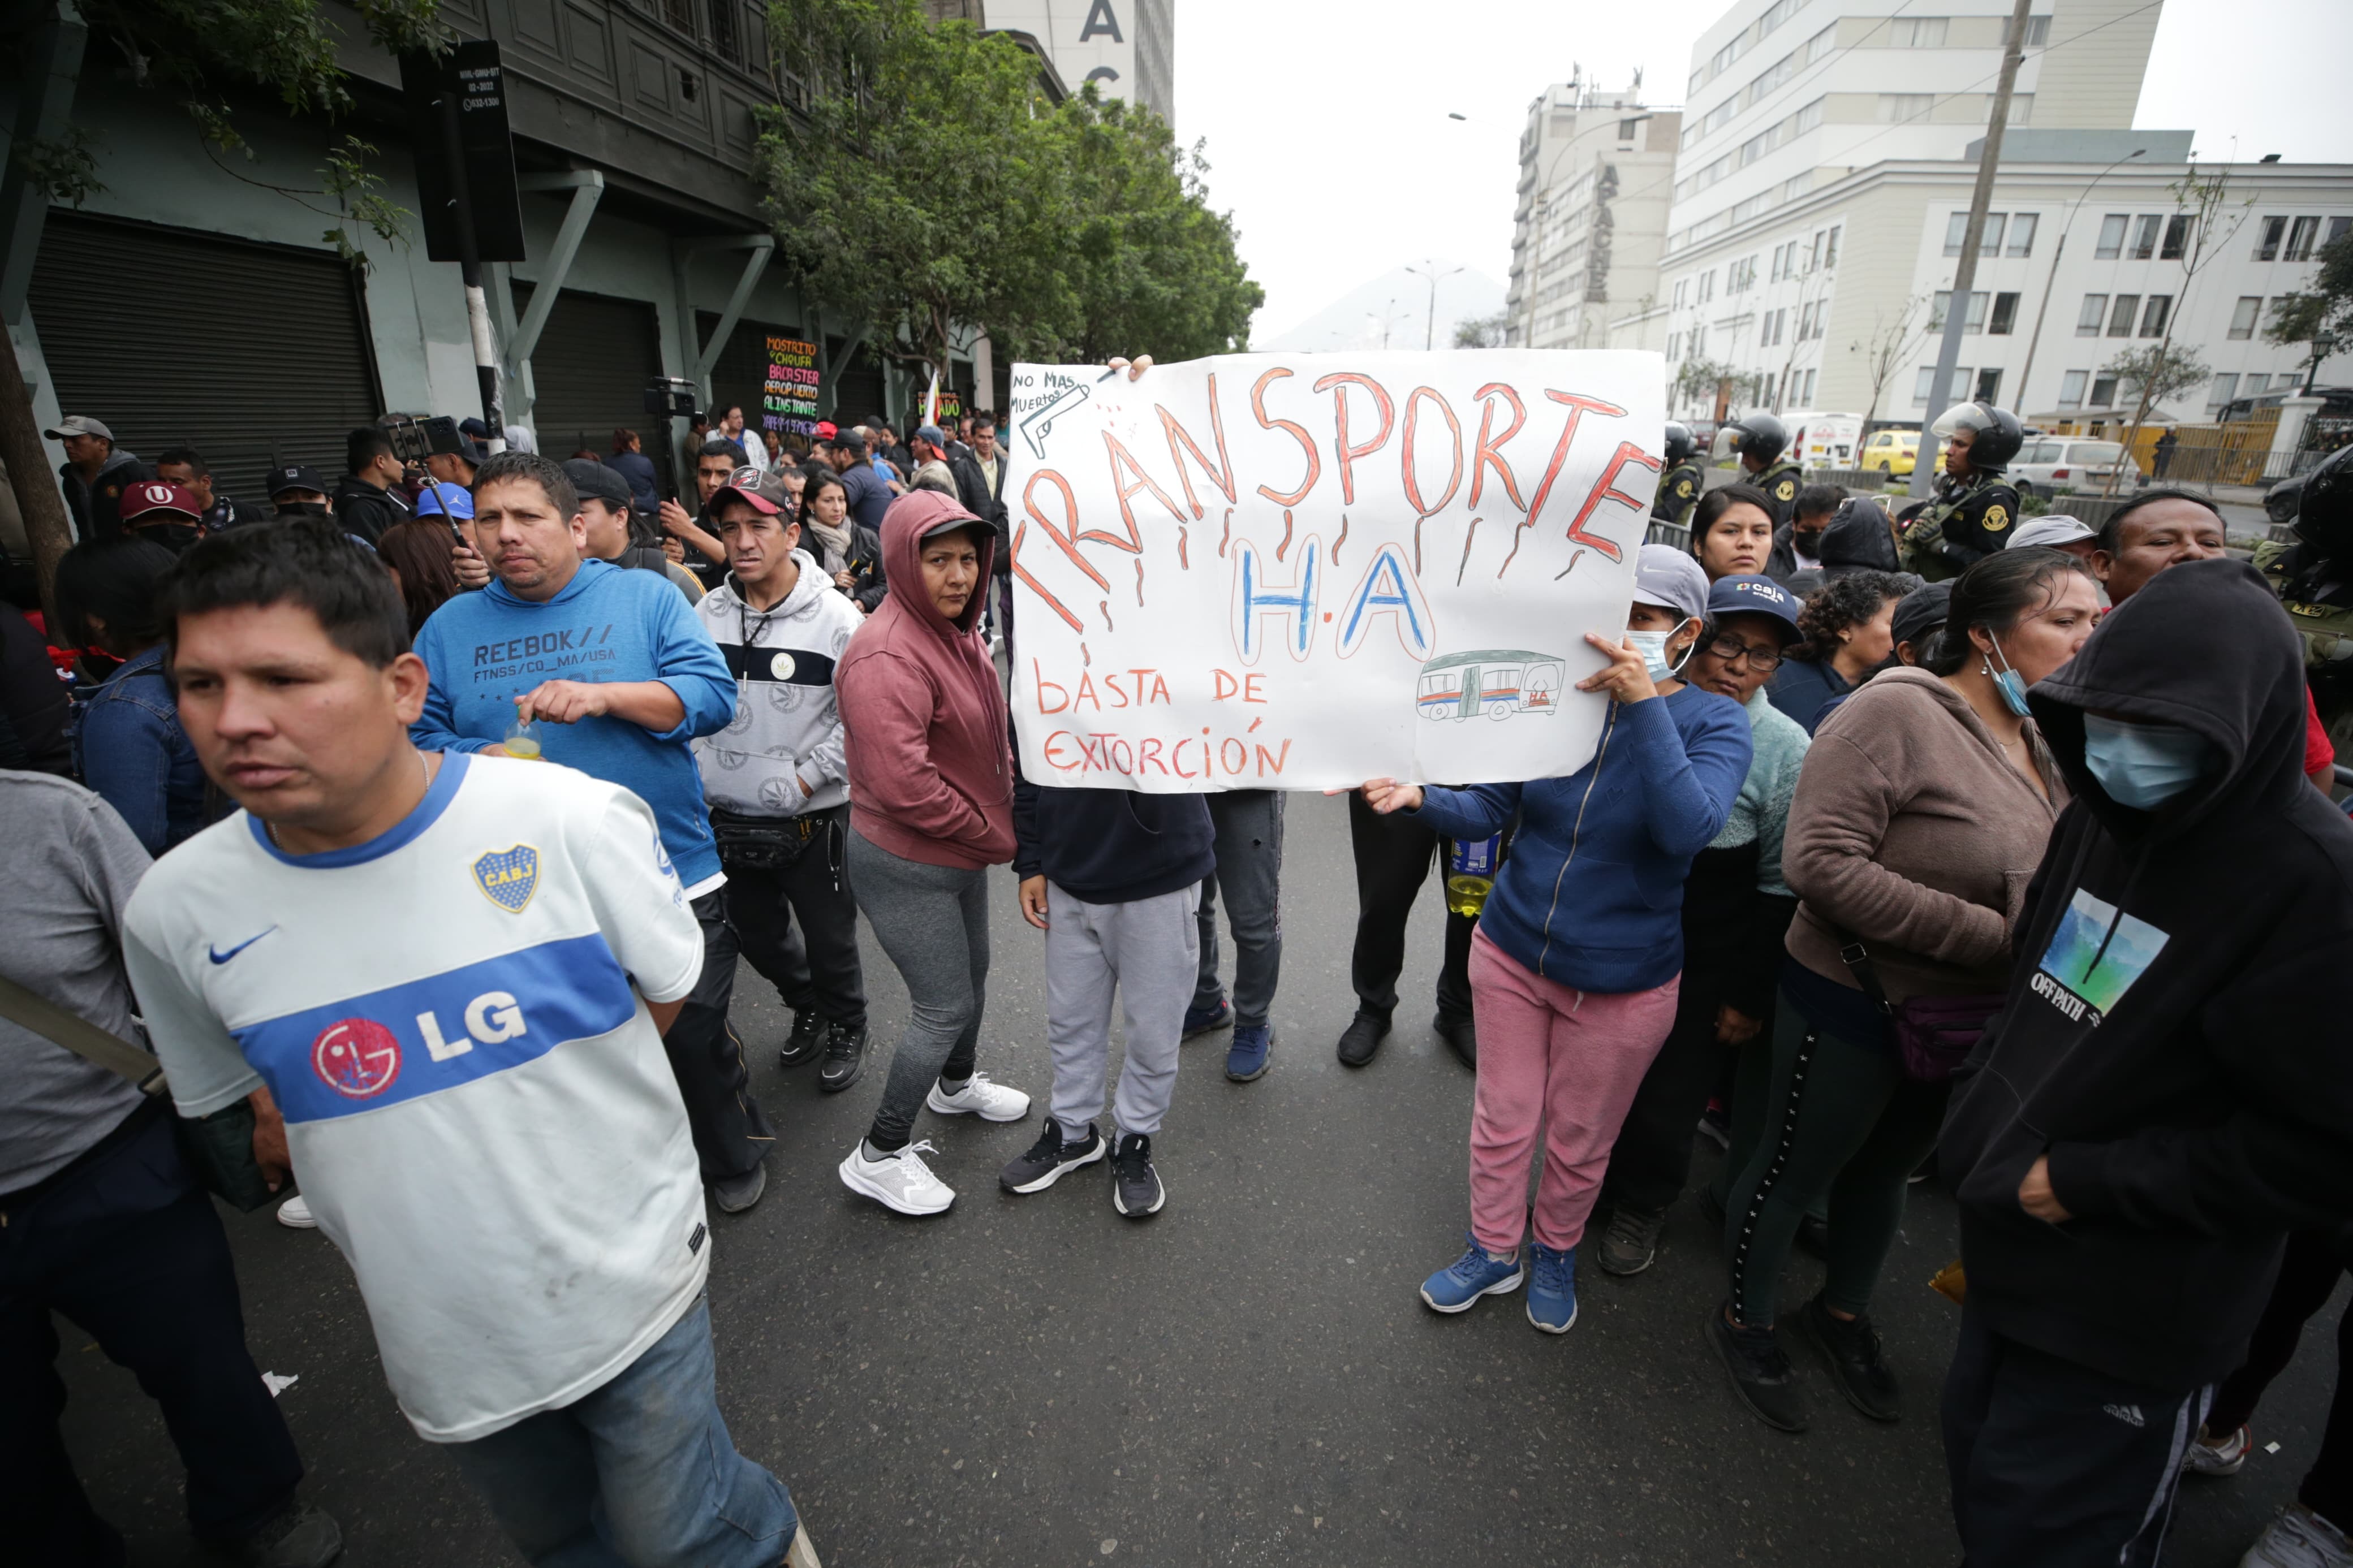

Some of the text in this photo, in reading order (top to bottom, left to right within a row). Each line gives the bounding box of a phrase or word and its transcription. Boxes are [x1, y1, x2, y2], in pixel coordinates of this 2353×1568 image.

[766, 338, 816, 356] MOSTRITO
[1013, 371, 1075, 390] NO MAS
[149, 488, 168, 502] U
[1010, 367, 1662, 634] TRANSPORTE
[1752, 583, 1785, 603] caja
[1209, 668, 1268, 704] DE
[485, 863, 533, 887] CABJ
[2031, 973, 2087, 1022] OFF PATH
[416, 991, 527, 1063] LG
